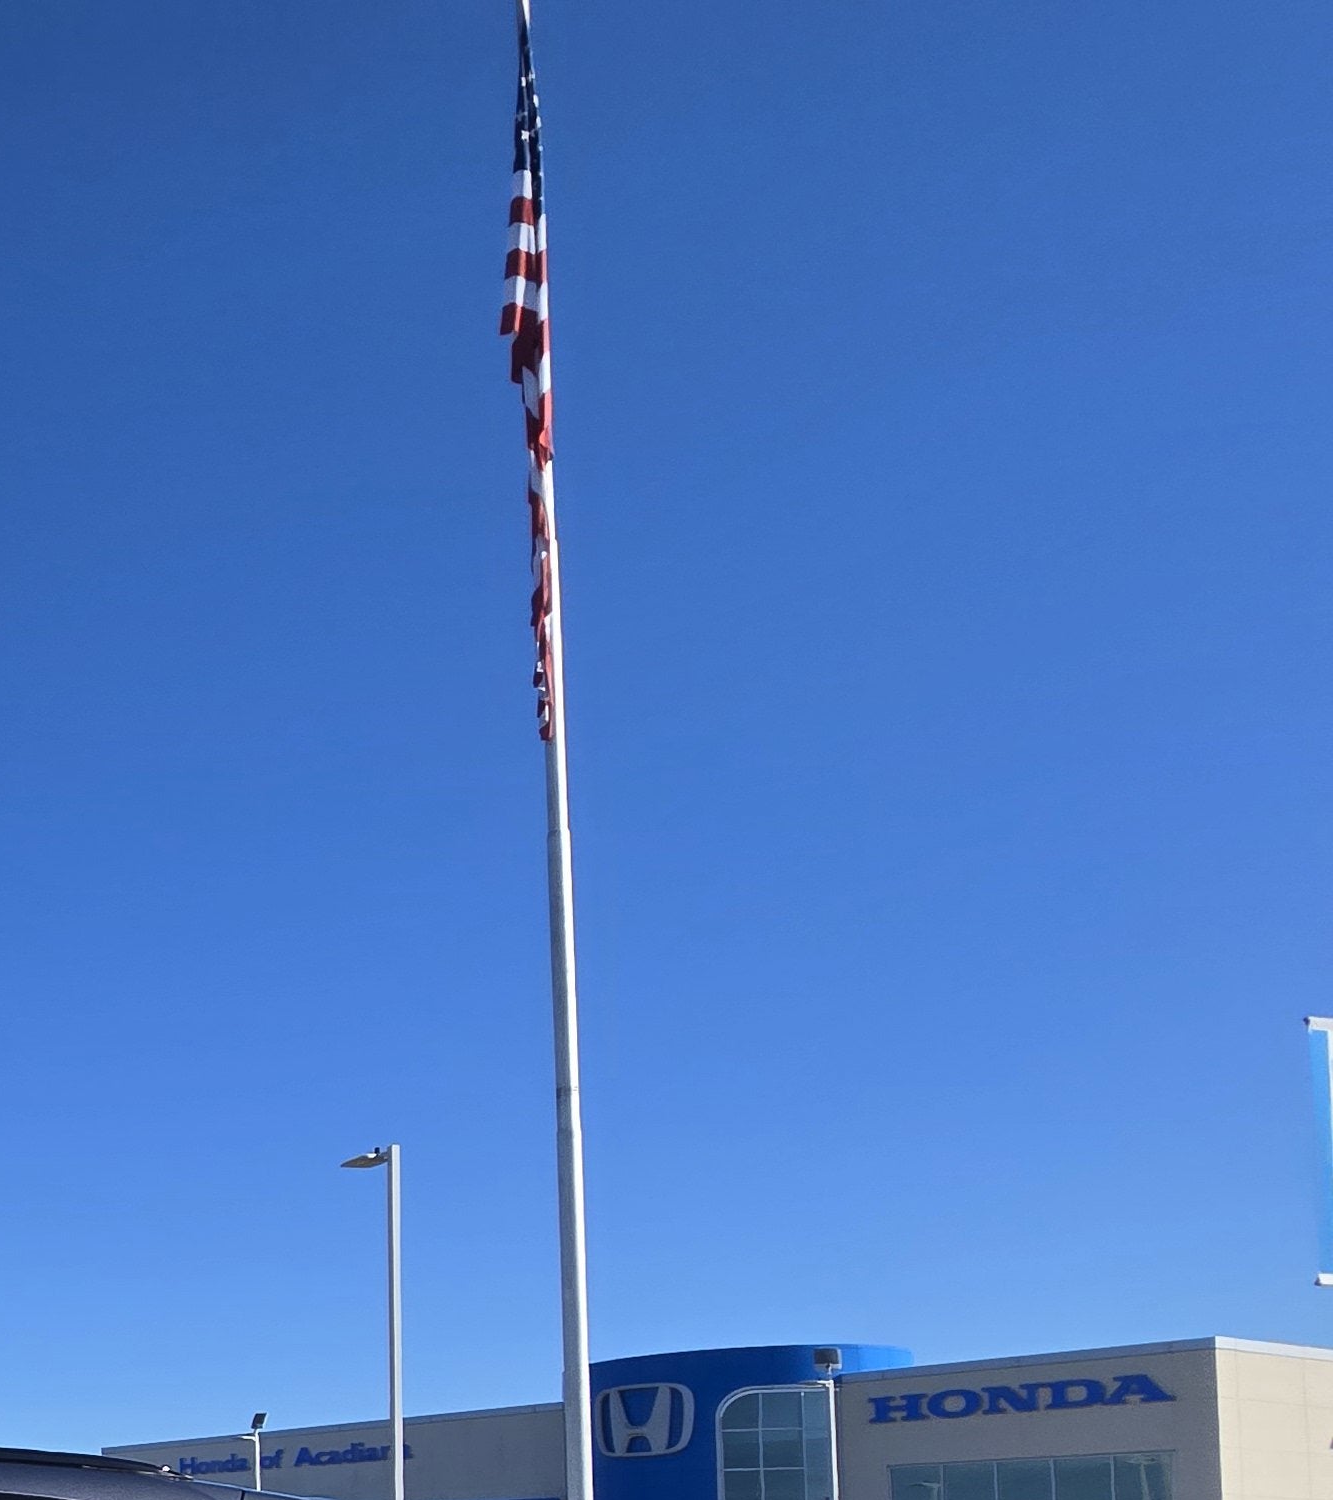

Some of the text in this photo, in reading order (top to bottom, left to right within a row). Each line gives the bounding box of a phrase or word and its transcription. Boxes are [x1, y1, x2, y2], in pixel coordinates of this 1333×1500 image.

[869, 1374, 1177, 1424] HONDA
[179, 1453, 250, 1475] Honda
[261, 1449, 284, 1469] of
